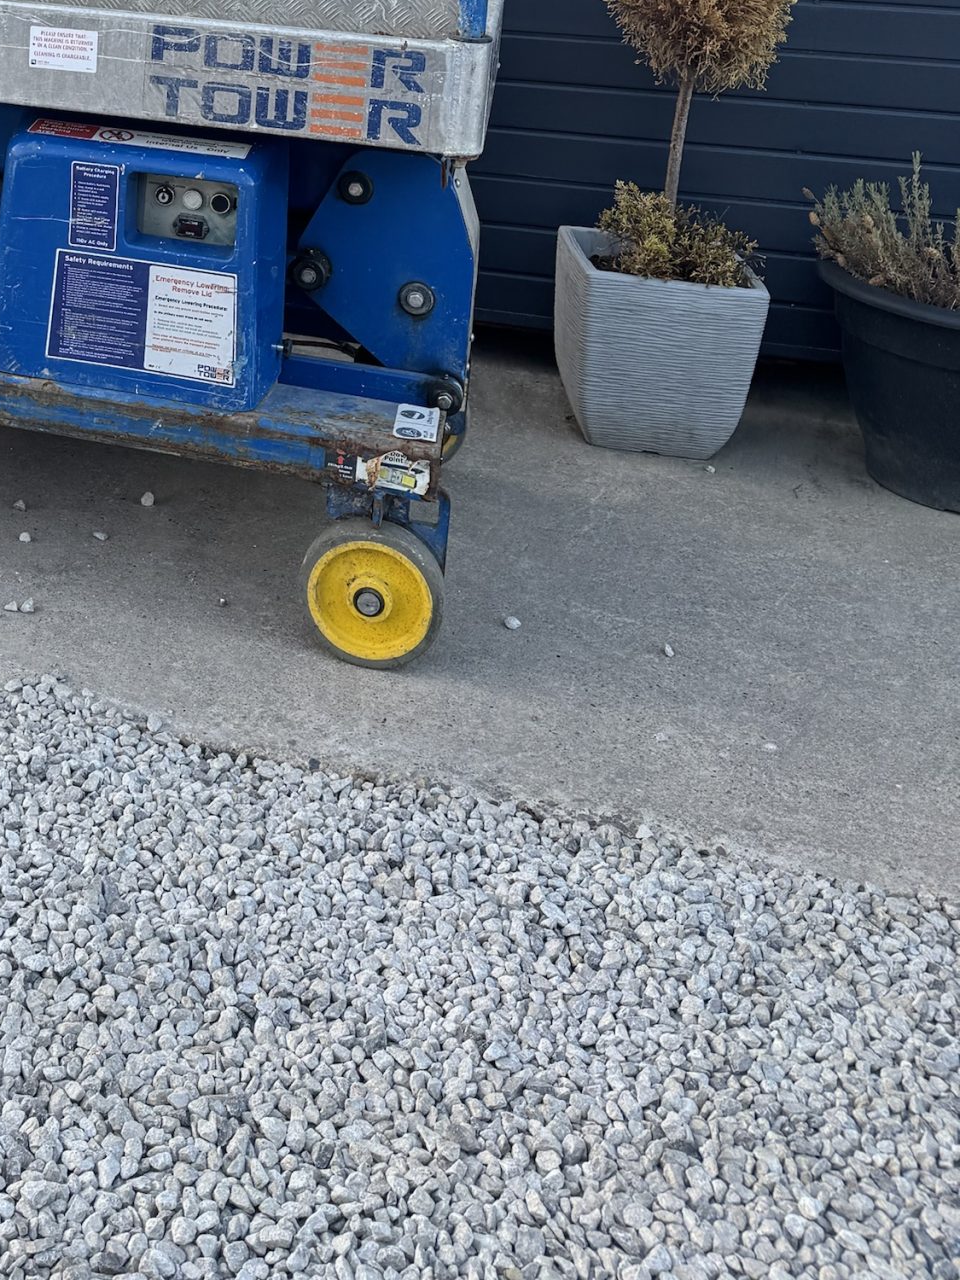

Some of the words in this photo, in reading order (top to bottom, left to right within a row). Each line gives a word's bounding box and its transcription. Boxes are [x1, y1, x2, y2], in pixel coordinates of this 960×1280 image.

[150, 24, 426, 94] POWER
[149, 74, 423, 147] TOWER
[145, 139, 183, 148] Internal
[76, 165, 94, 173] Battery
[94, 167, 115, 175] Charging
[65, 255, 87, 265] Safety
[88, 257, 134, 271] Requirements
[155, 275, 195, 287] Emergency
[172, 285, 200, 296] Remove
[201, 290, 212, 298] Lid
[155, 295, 180, 304] Emergency
[181, 299, 202, 308] Lowering
[197, 363, 231, 376] POWER
[198, 370, 230, 382] TOWER
[384, 455, 404, 464] Point
